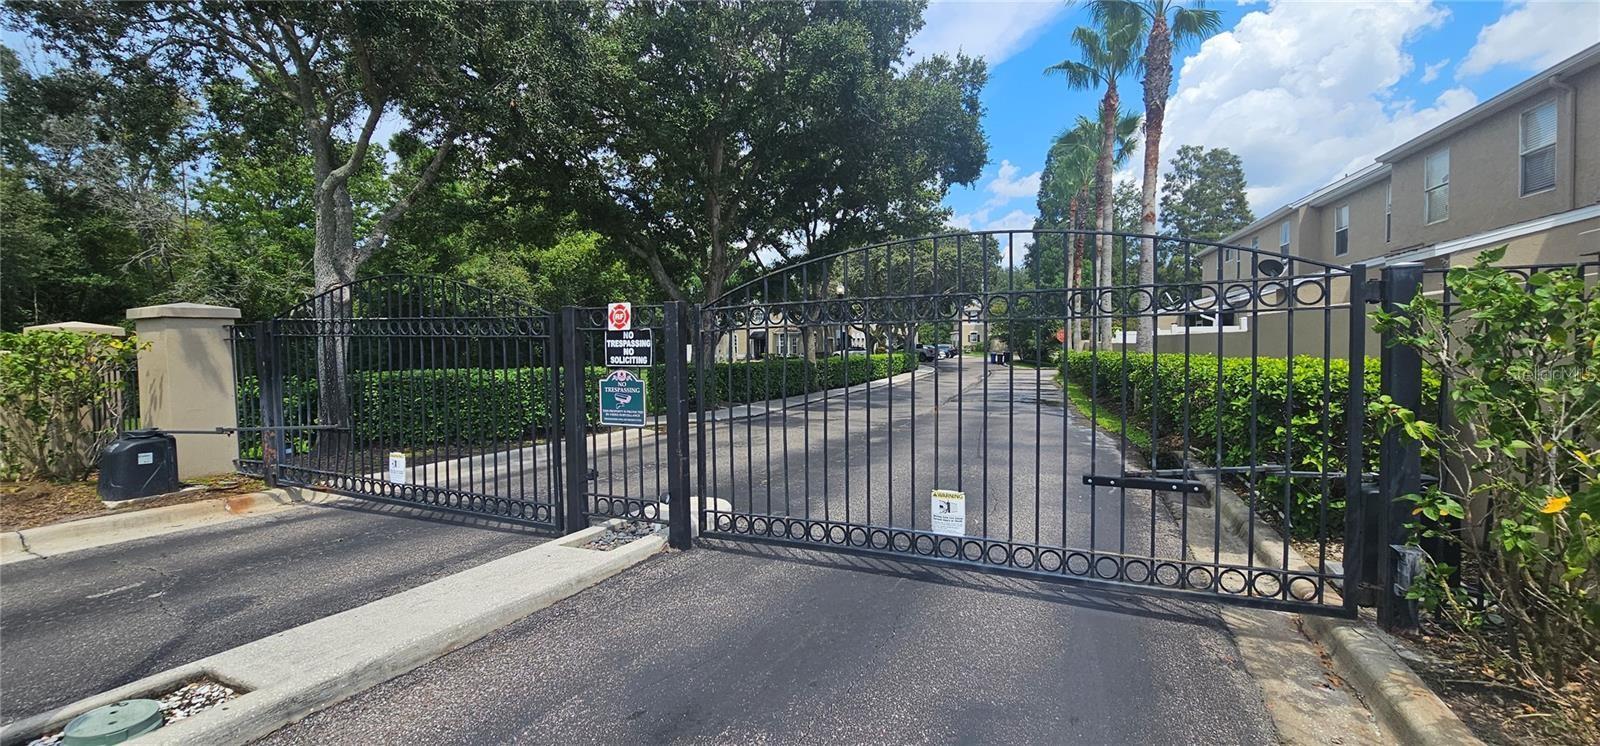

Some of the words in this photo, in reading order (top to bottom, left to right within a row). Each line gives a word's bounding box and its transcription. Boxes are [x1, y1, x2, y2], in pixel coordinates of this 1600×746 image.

[623, 331, 634, 339] NO
[623, 347, 635, 355] NO
[610, 356, 648, 364] SOLICITING
[604, 386, 641, 394] TRESPASSING
